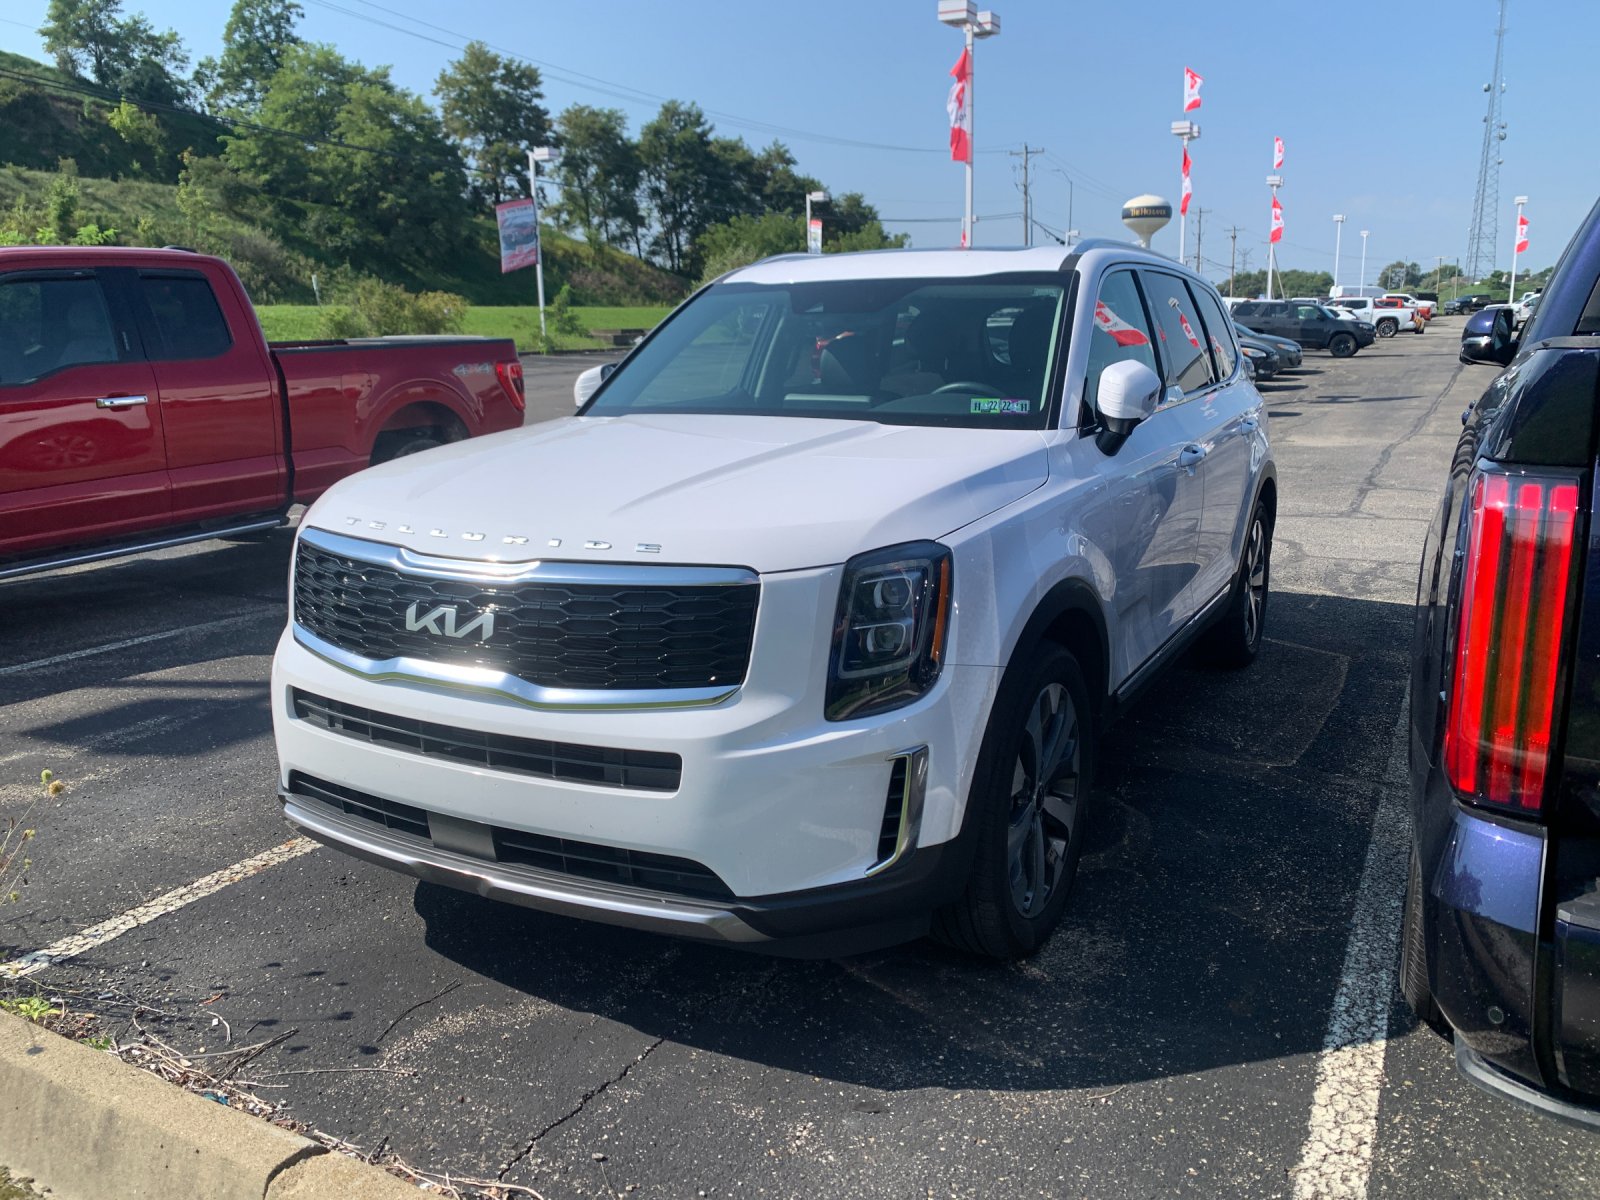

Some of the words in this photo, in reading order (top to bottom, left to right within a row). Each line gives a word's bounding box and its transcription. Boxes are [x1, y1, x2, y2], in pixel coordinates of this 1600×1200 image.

[989, 400, 998, 411] 22
[1002, 400, 1011, 411] 22
[346, 516, 663, 554] TELLURIDE
[405, 603, 495, 641] KIA
